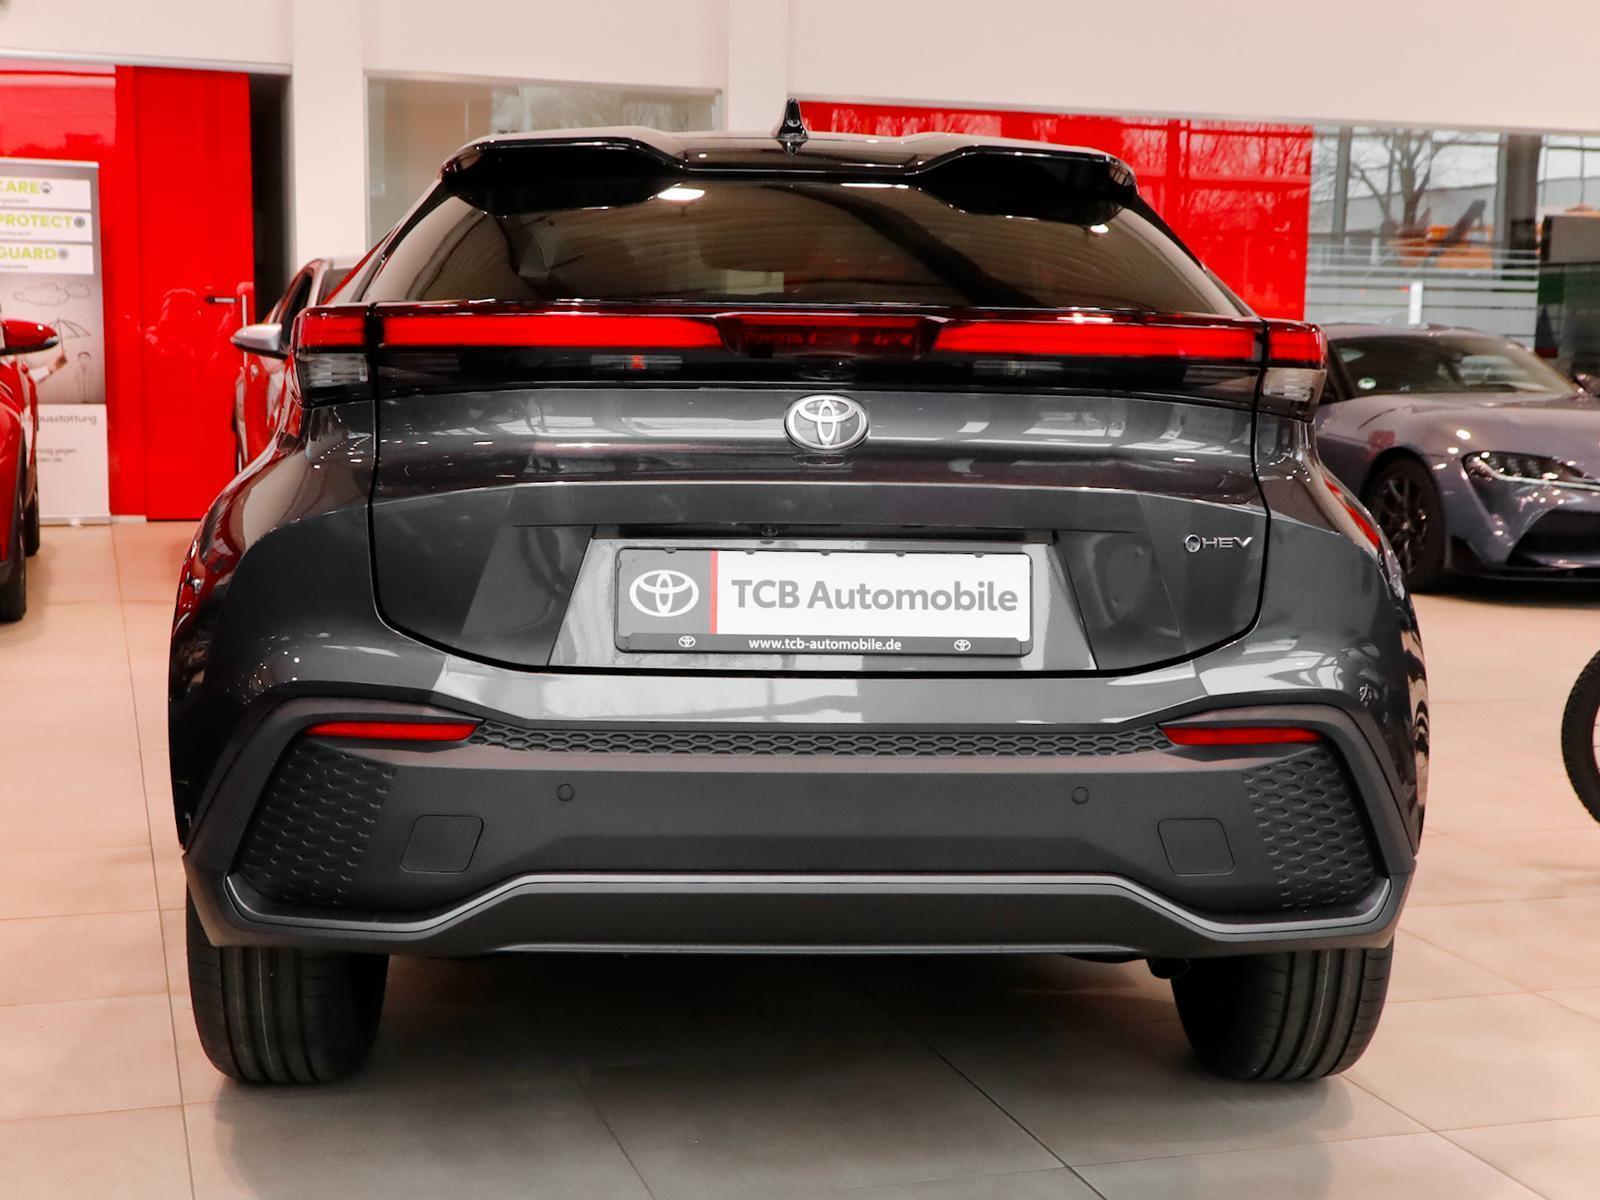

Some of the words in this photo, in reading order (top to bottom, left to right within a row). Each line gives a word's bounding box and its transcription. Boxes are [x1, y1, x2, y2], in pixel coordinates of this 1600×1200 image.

[0, 247, 56, 260] GUARD
[1201, 536, 1254, 549] HEV
[731, 579, 800, 609] TCB
[806, 580, 1018, 612] Automobile
[748, 637, 902, 651] www.tcb-automobile.de
